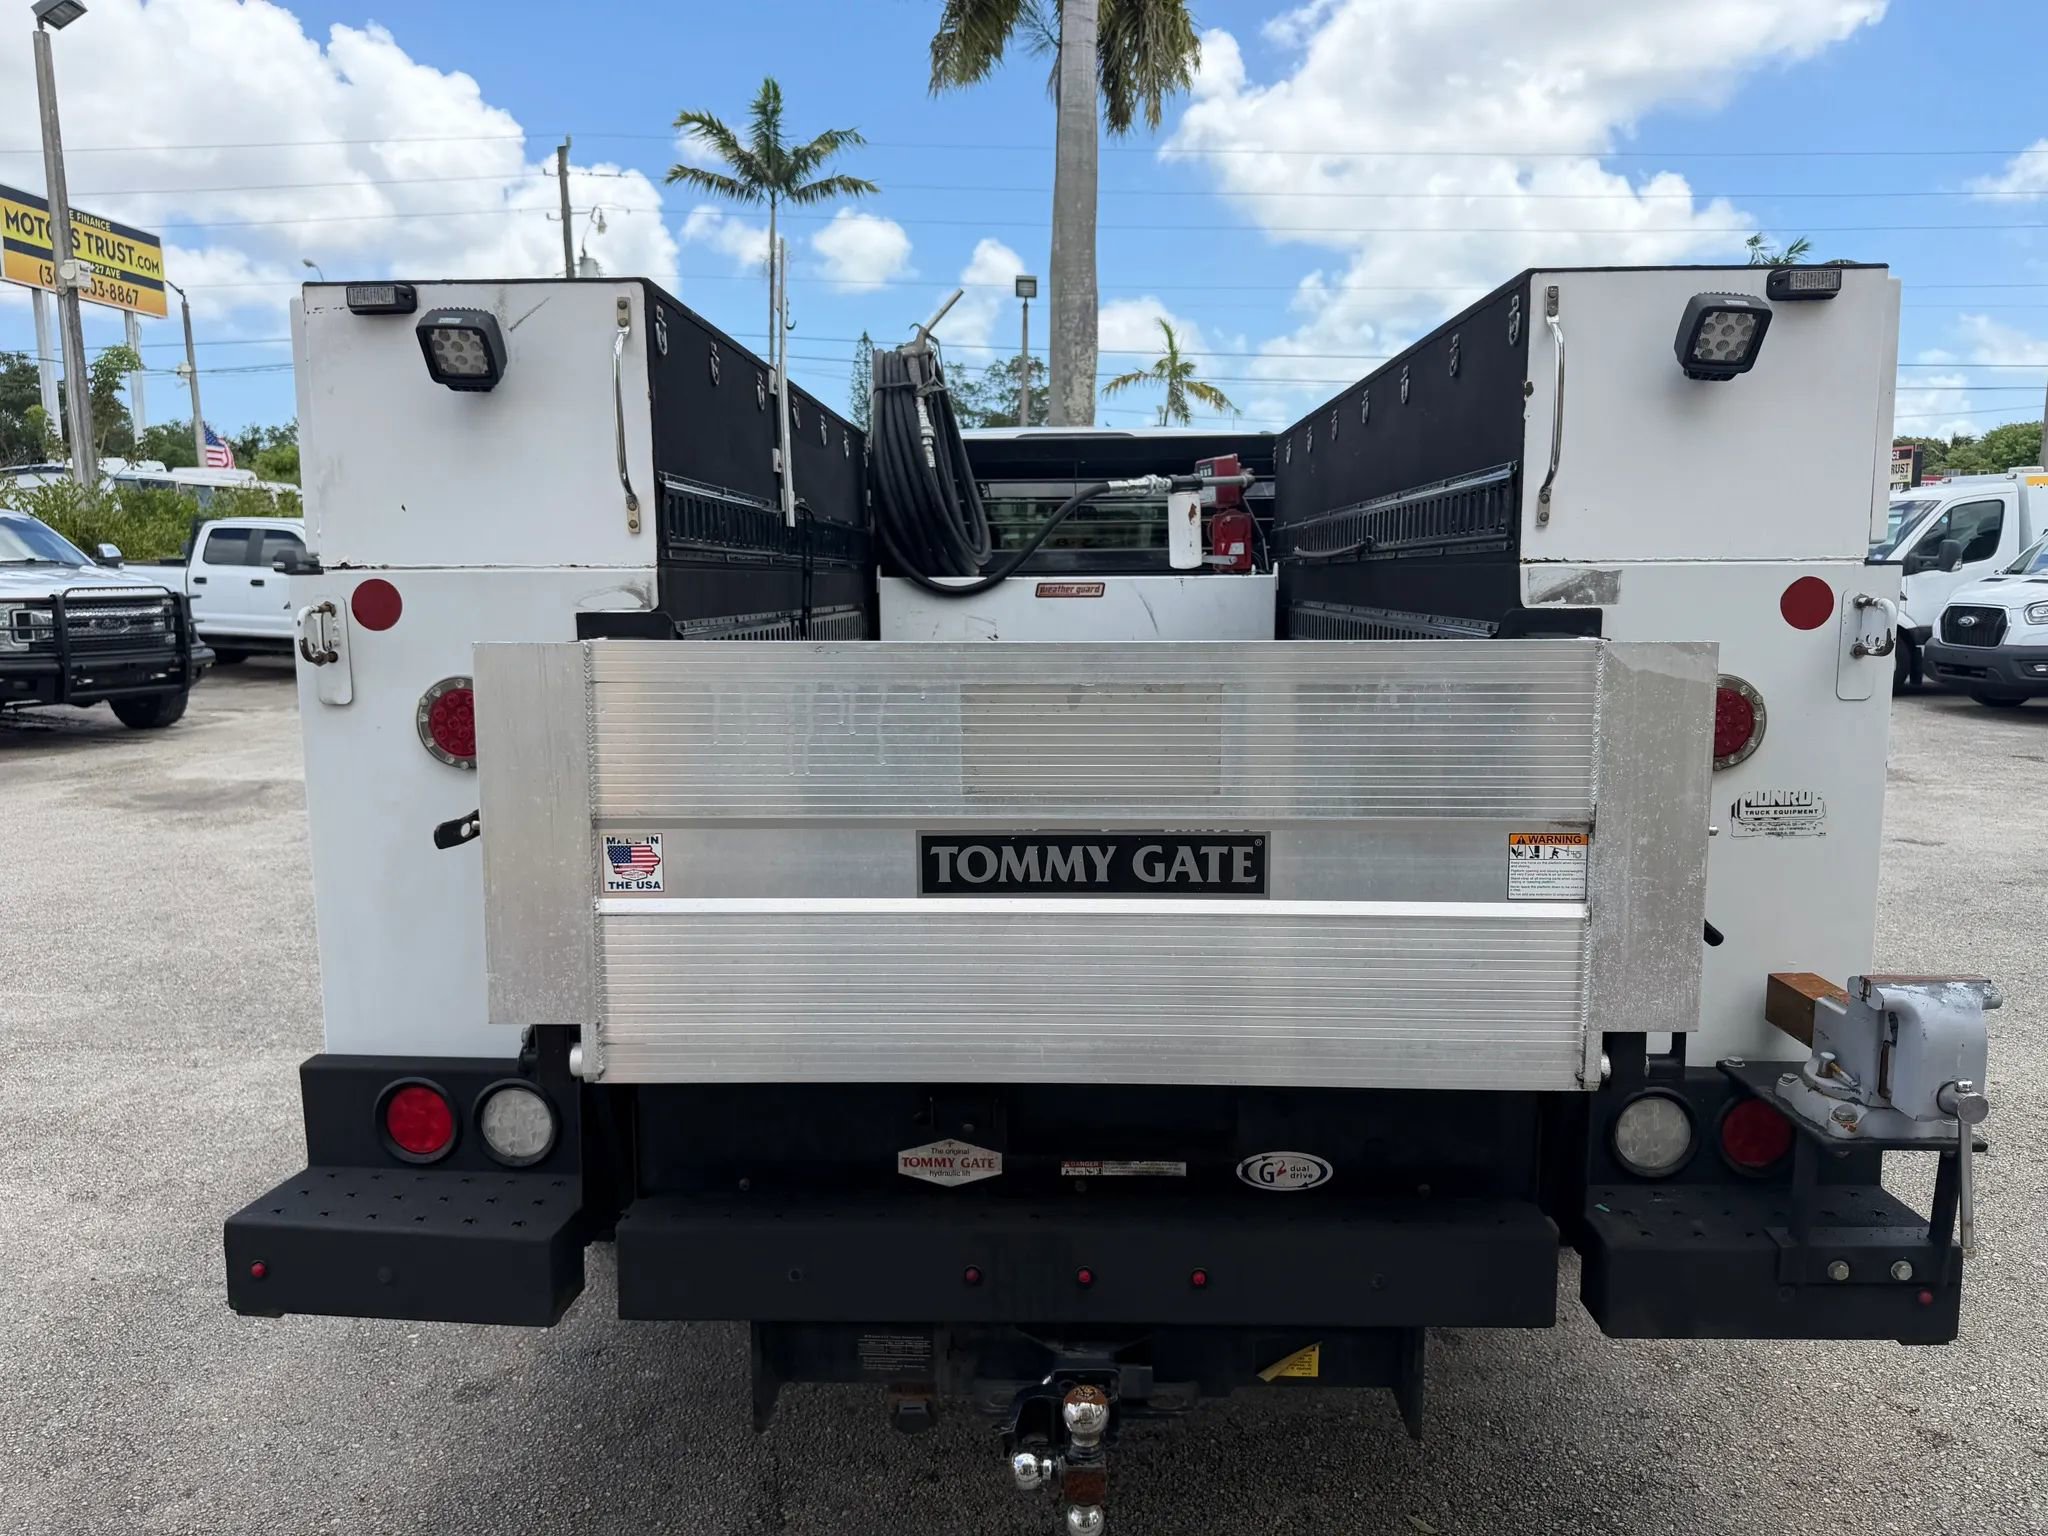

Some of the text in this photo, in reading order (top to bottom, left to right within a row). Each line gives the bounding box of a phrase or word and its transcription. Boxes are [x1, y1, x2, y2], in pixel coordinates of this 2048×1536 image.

[76, 213, 112, 232] FINANCE
[4, 206, 161, 275] MOTS TRUST.COM
[105, 265, 121, 279] AVE
[1075, 583, 1101, 595] guard
[646, 836, 659, 845] IN
[1527, 835, 1582, 844] WARNING
[929, 844, 1117, 884] TOMMY
[607, 881, 661, 890] THE USA
[931, 1147, 970, 1156] The original
[902, 1156, 996, 1169] TOMMY GATE
